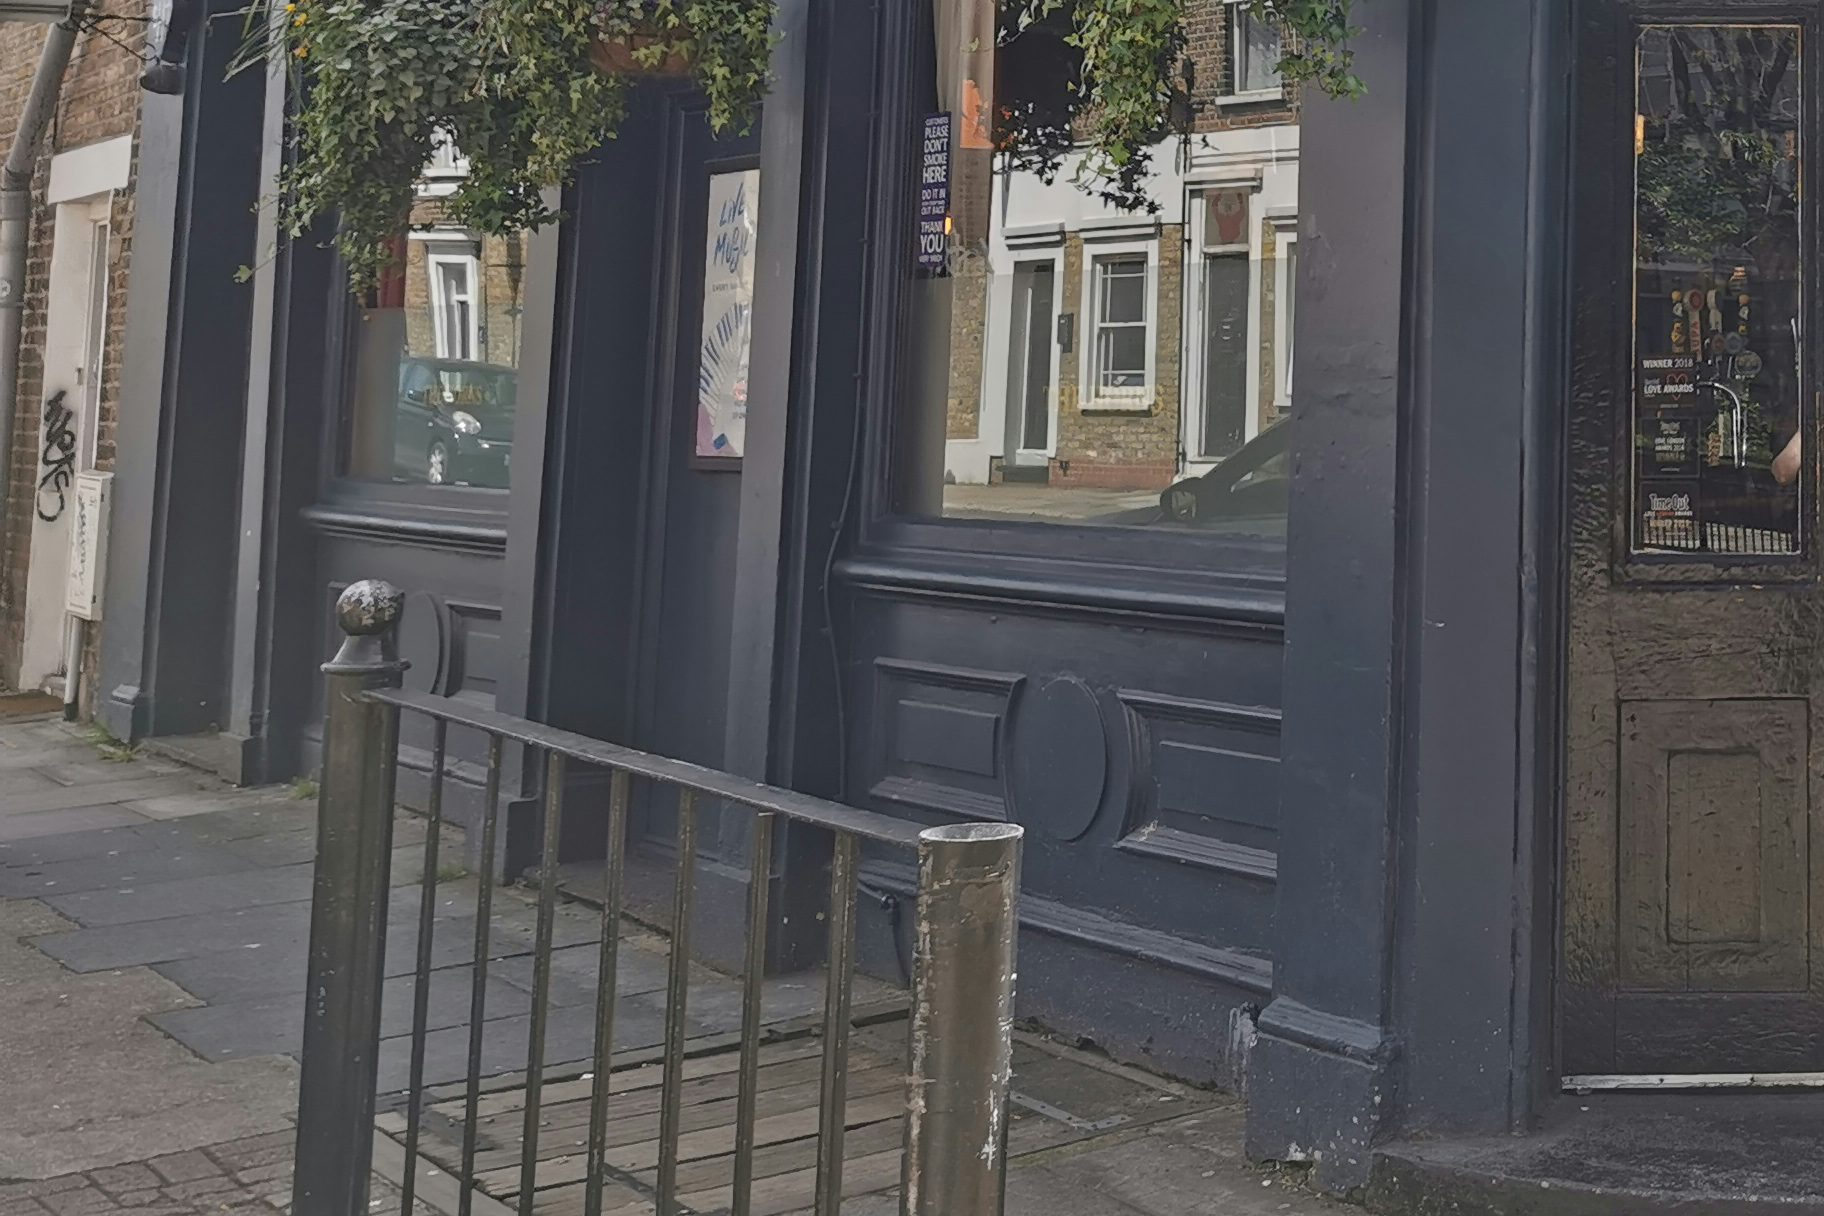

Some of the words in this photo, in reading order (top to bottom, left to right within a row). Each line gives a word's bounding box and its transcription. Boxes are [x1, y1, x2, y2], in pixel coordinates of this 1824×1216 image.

[925, 125, 949, 139] PLEASE
[924, 152, 947, 166] SMOKE
[923, 165, 947, 184] HERE
[921, 189, 931, 200] DO
[921, 220, 943, 233] THANK
[920, 234, 944, 254] YOU
[1643, 360, 1673, 369] WINNER
[1674, 358, 1694, 368] 2018
[1643, 385, 1662, 395] LOVE
[1663, 384, 1694, 394] AWARDS
